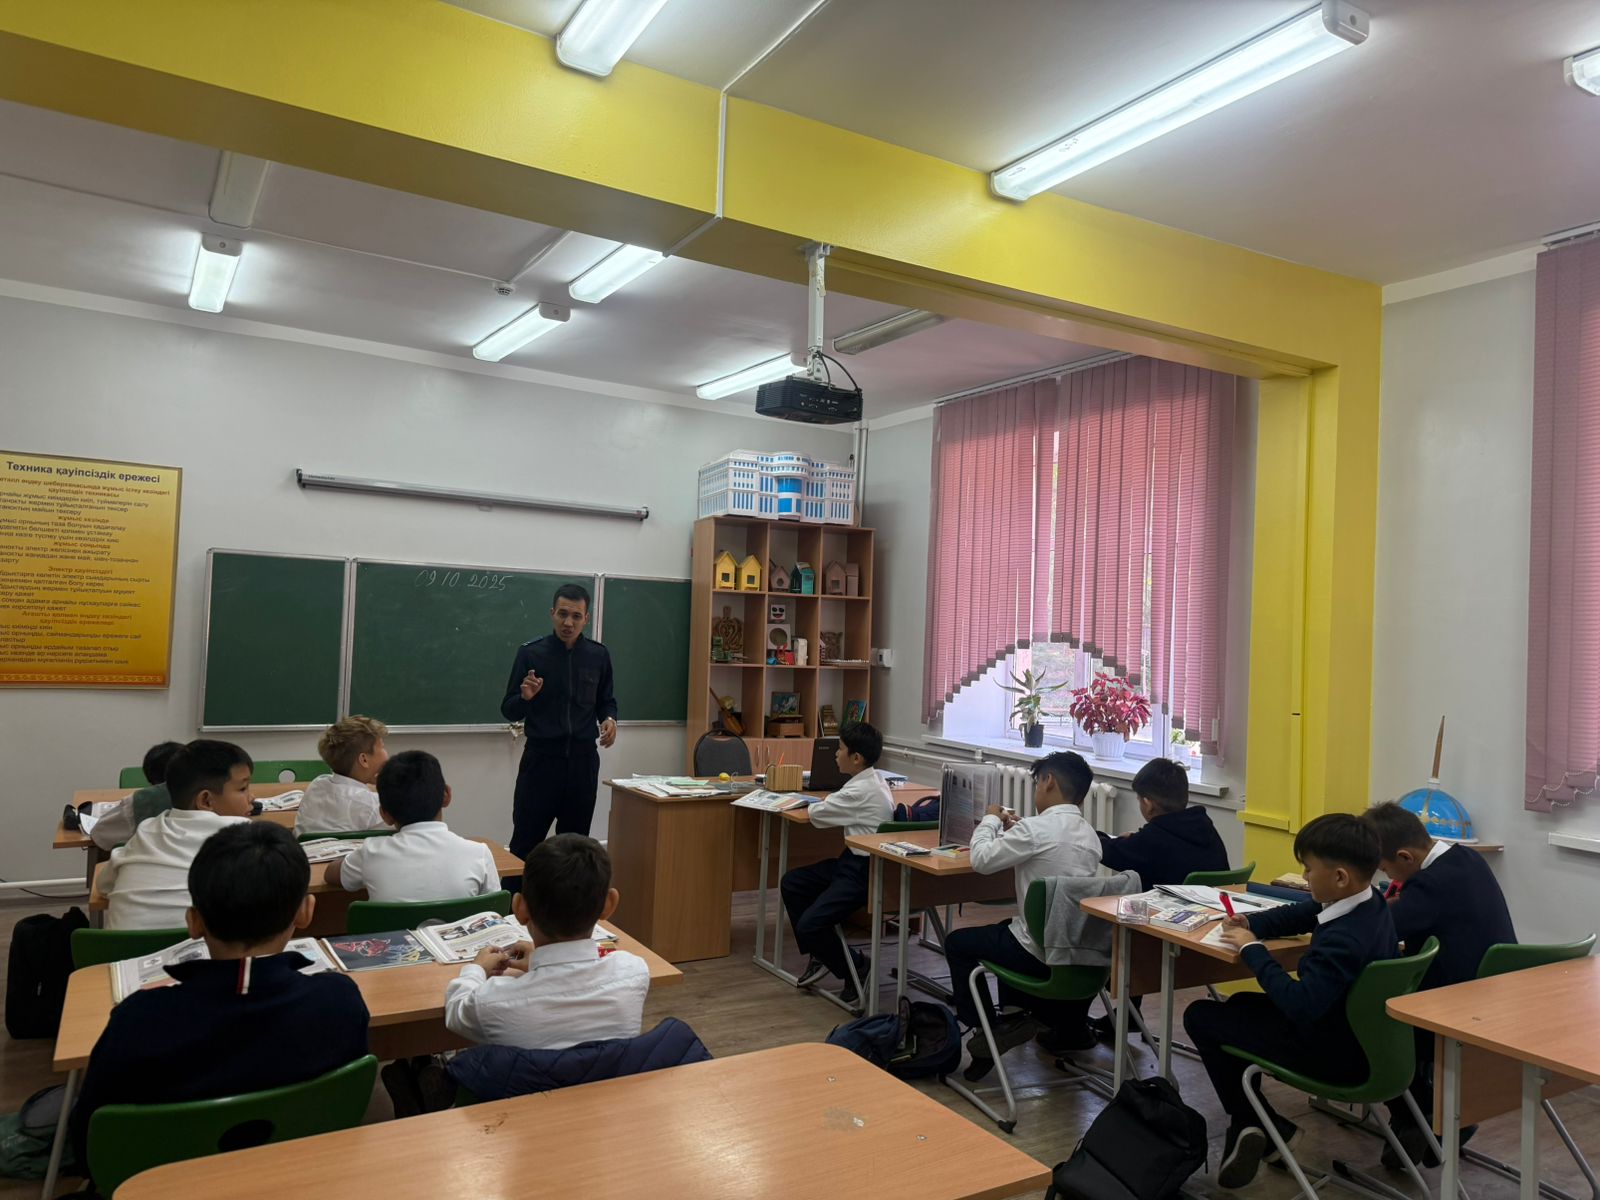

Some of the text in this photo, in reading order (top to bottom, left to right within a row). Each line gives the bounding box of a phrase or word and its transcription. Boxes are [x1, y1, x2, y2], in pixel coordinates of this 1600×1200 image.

[6, 461, 161, 484] Техника қауіпсіздік ережесі
[466, 573, 514, 591] 2025
